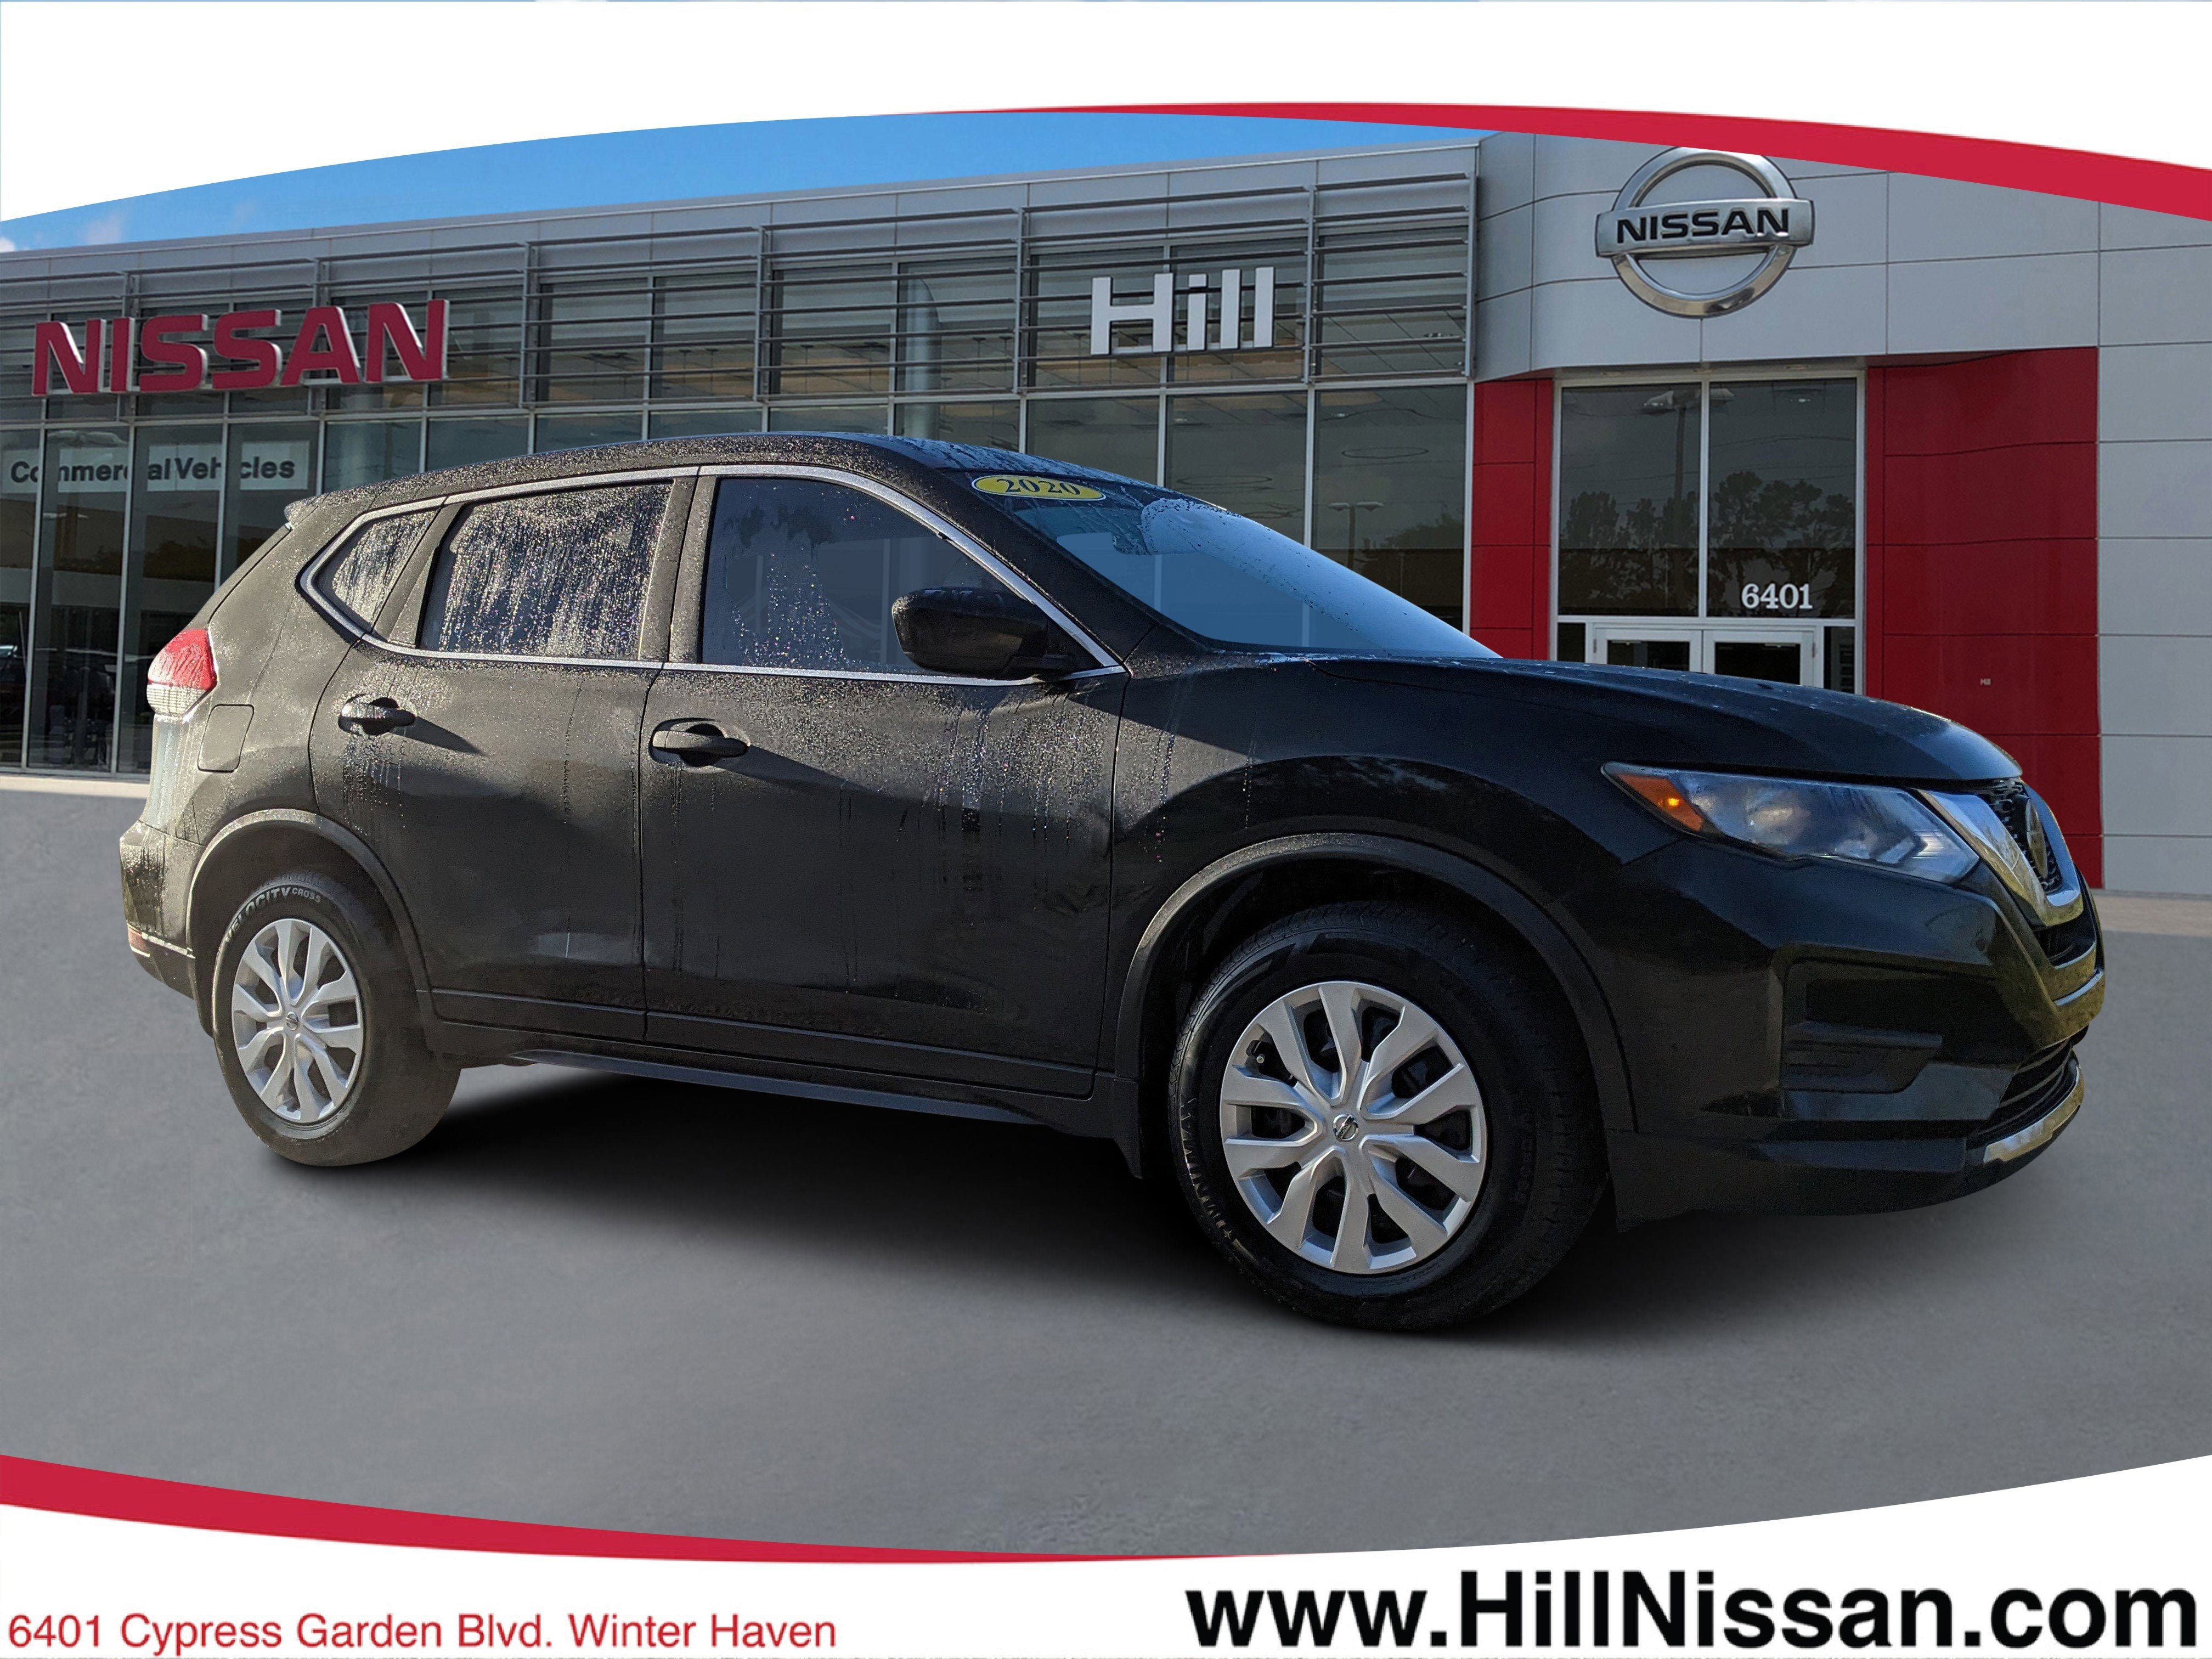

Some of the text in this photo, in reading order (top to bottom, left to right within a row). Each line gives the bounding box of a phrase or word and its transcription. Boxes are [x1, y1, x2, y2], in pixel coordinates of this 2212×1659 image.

[1616, 206, 1789, 244] NISSAN
[1090, 267, 1274, 356] Hill
[31, 299, 450, 396] NISSAN
[10, 455, 296, 483] Cmeral Vehcles
[995, 477, 1081, 496] 2020
[1740, 583, 1813, 610] 6401
